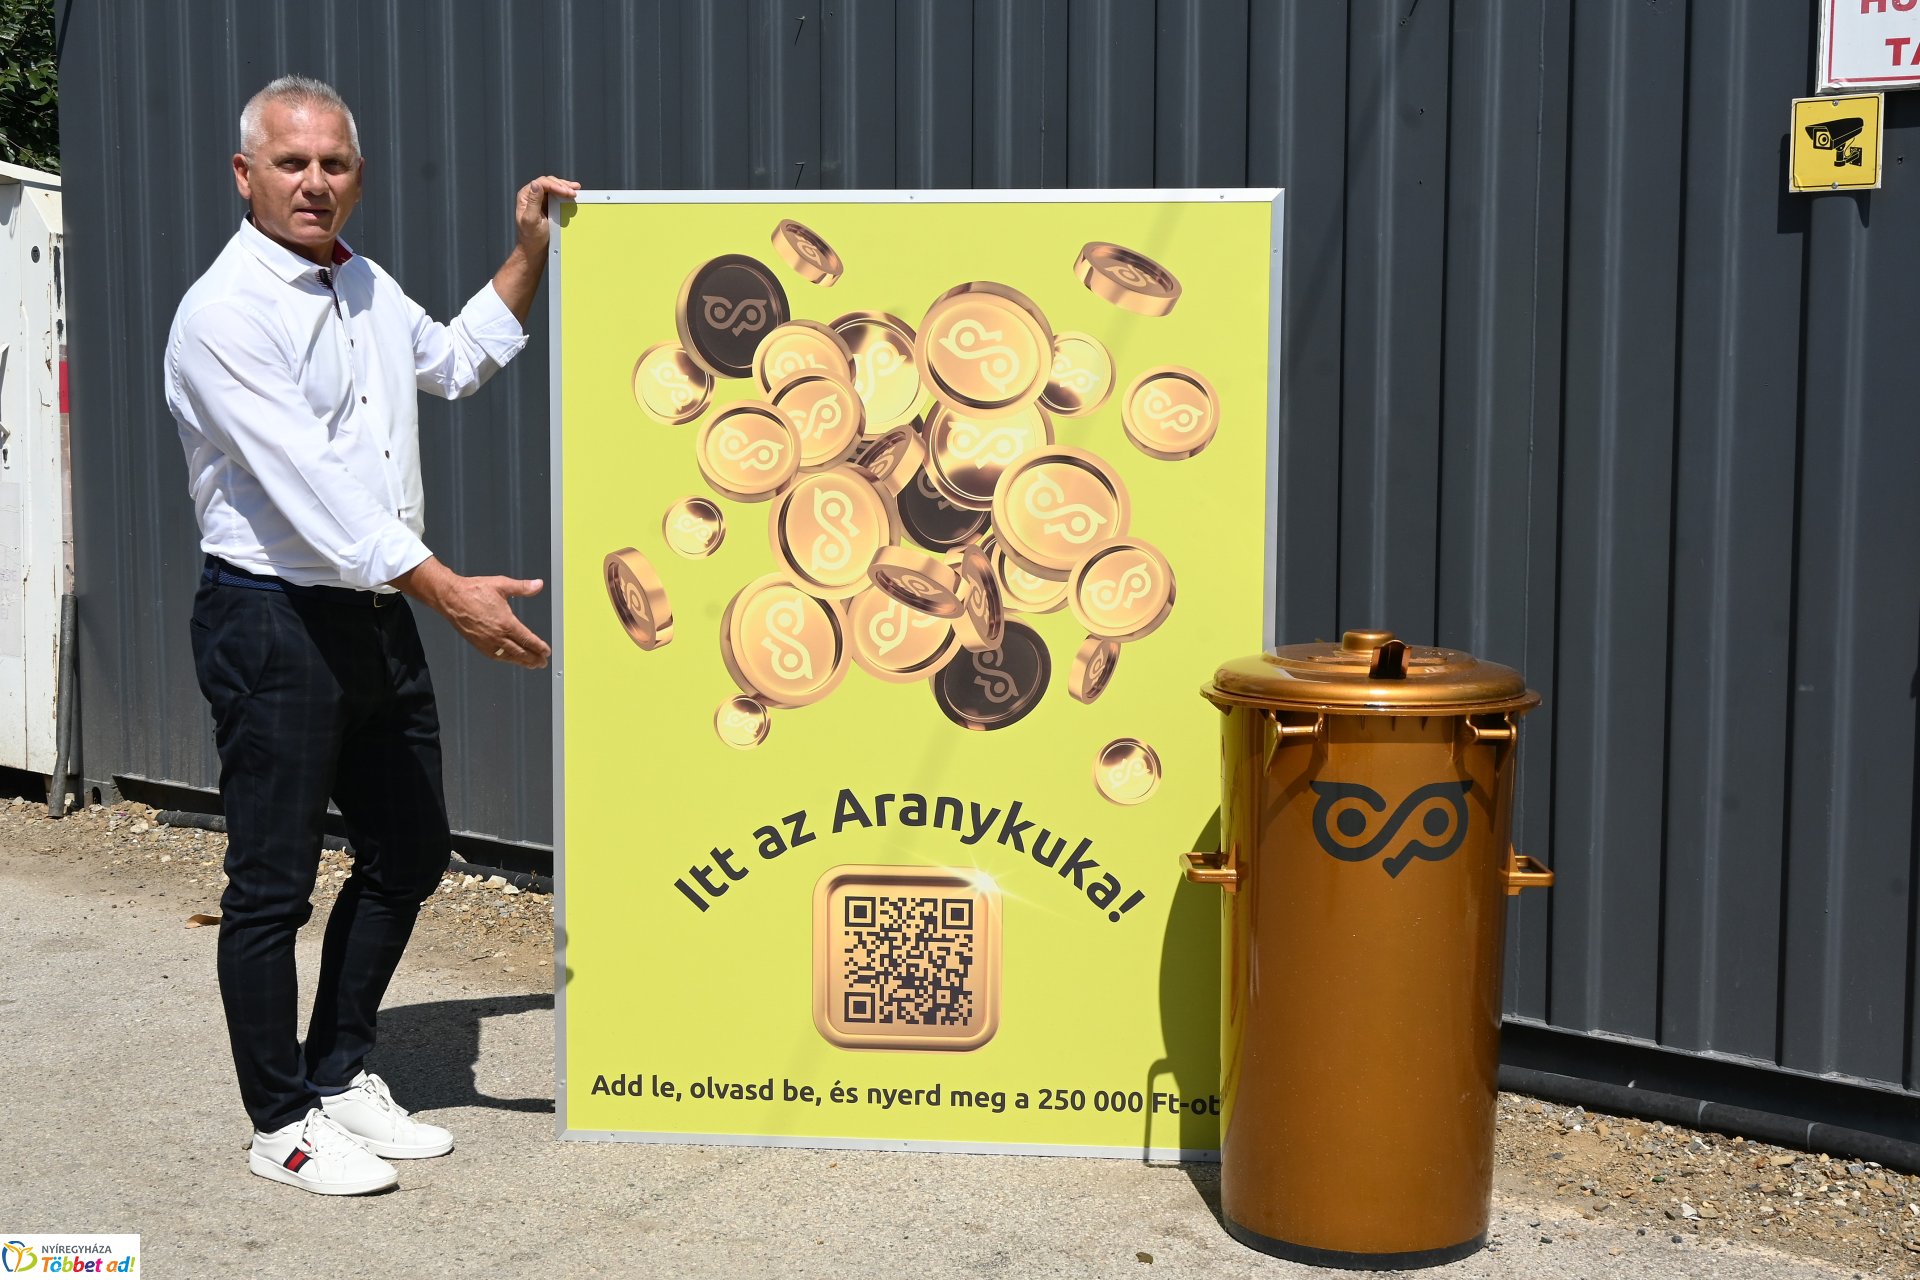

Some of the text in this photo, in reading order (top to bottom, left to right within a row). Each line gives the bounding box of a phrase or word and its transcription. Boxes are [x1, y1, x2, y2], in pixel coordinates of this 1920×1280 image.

[674, 789, 1145, 923] Itt az Aranykuka!
[591, 1074, 1220, 1115] Add le, olvasd be, és nyerd meg a 250 000 Ft-ot
